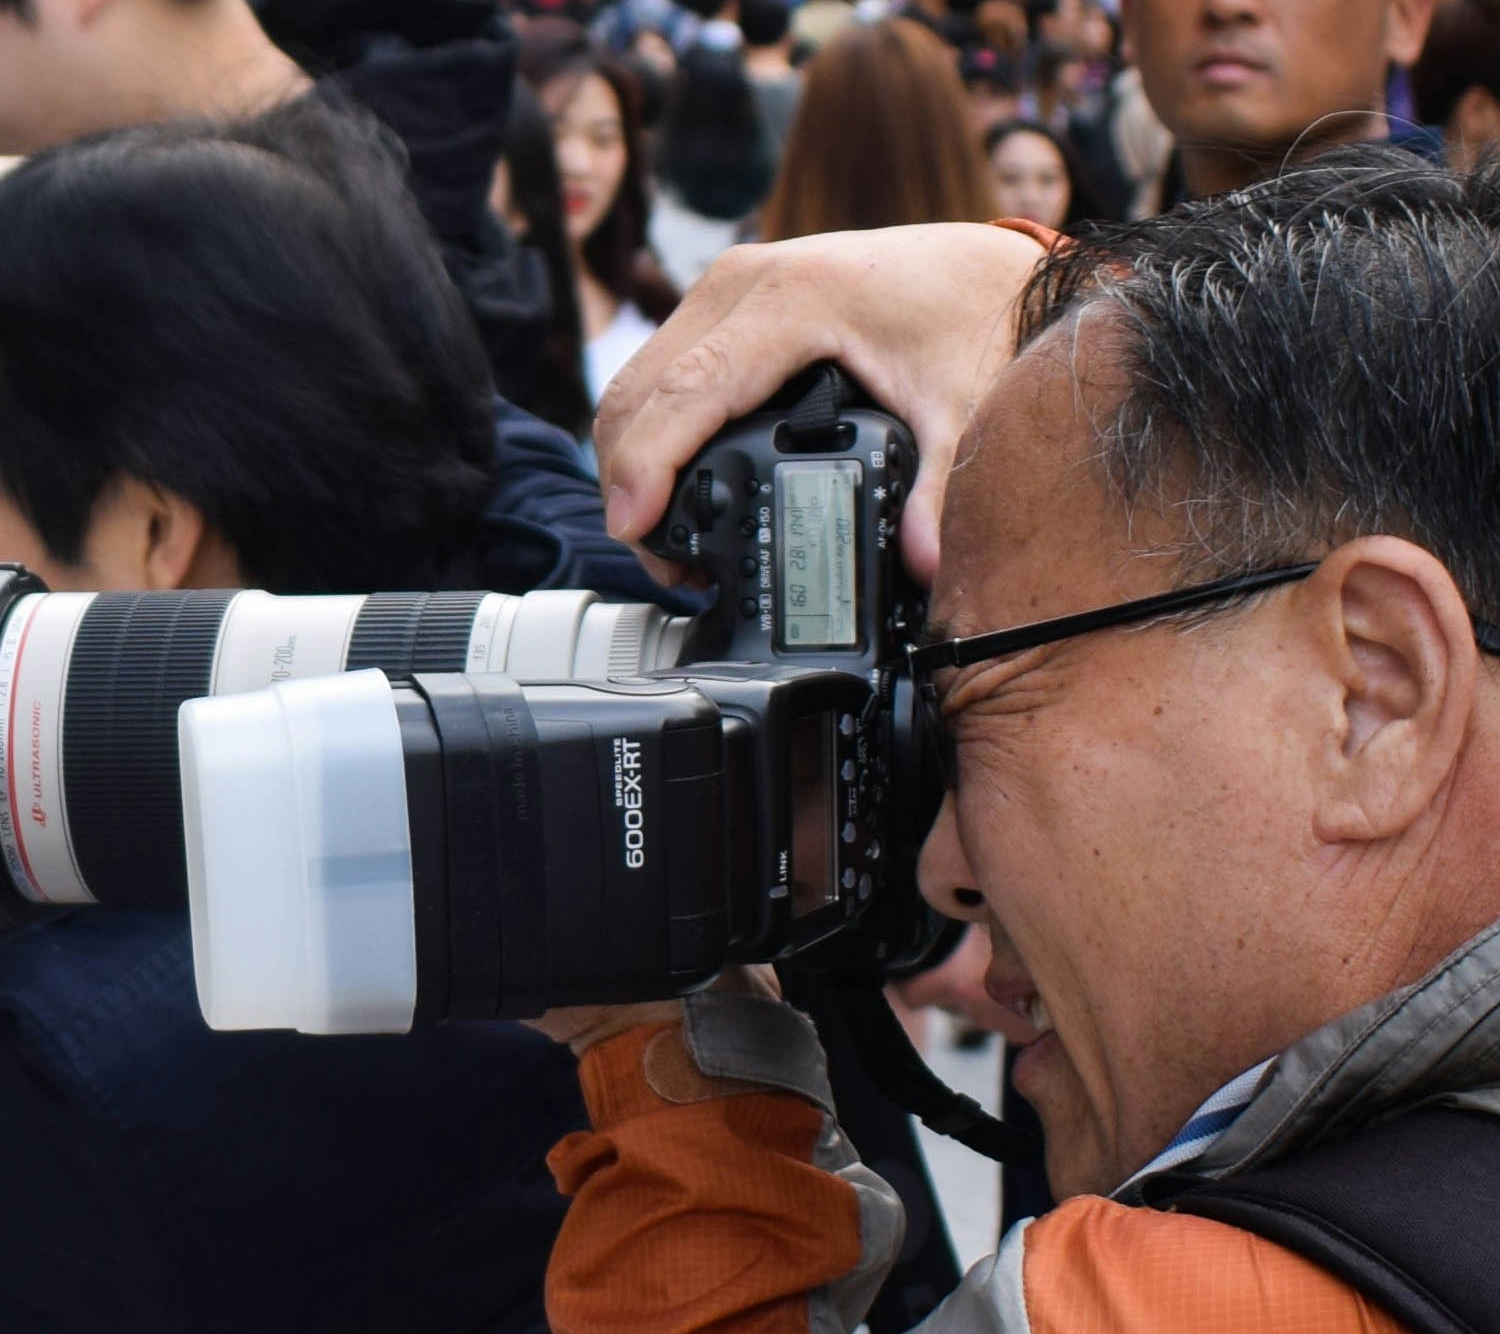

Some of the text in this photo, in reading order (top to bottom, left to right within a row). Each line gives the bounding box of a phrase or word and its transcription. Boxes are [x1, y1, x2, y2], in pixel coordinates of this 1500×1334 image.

[31, 701, 42, 800] ULTRASONIC
[613, 738, 623, 807] SPEEDLITE
[0, 812, 10, 837] LENS
[621, 737, 645, 869] 600EX-RT
[779, 850, 788, 882] LINK
